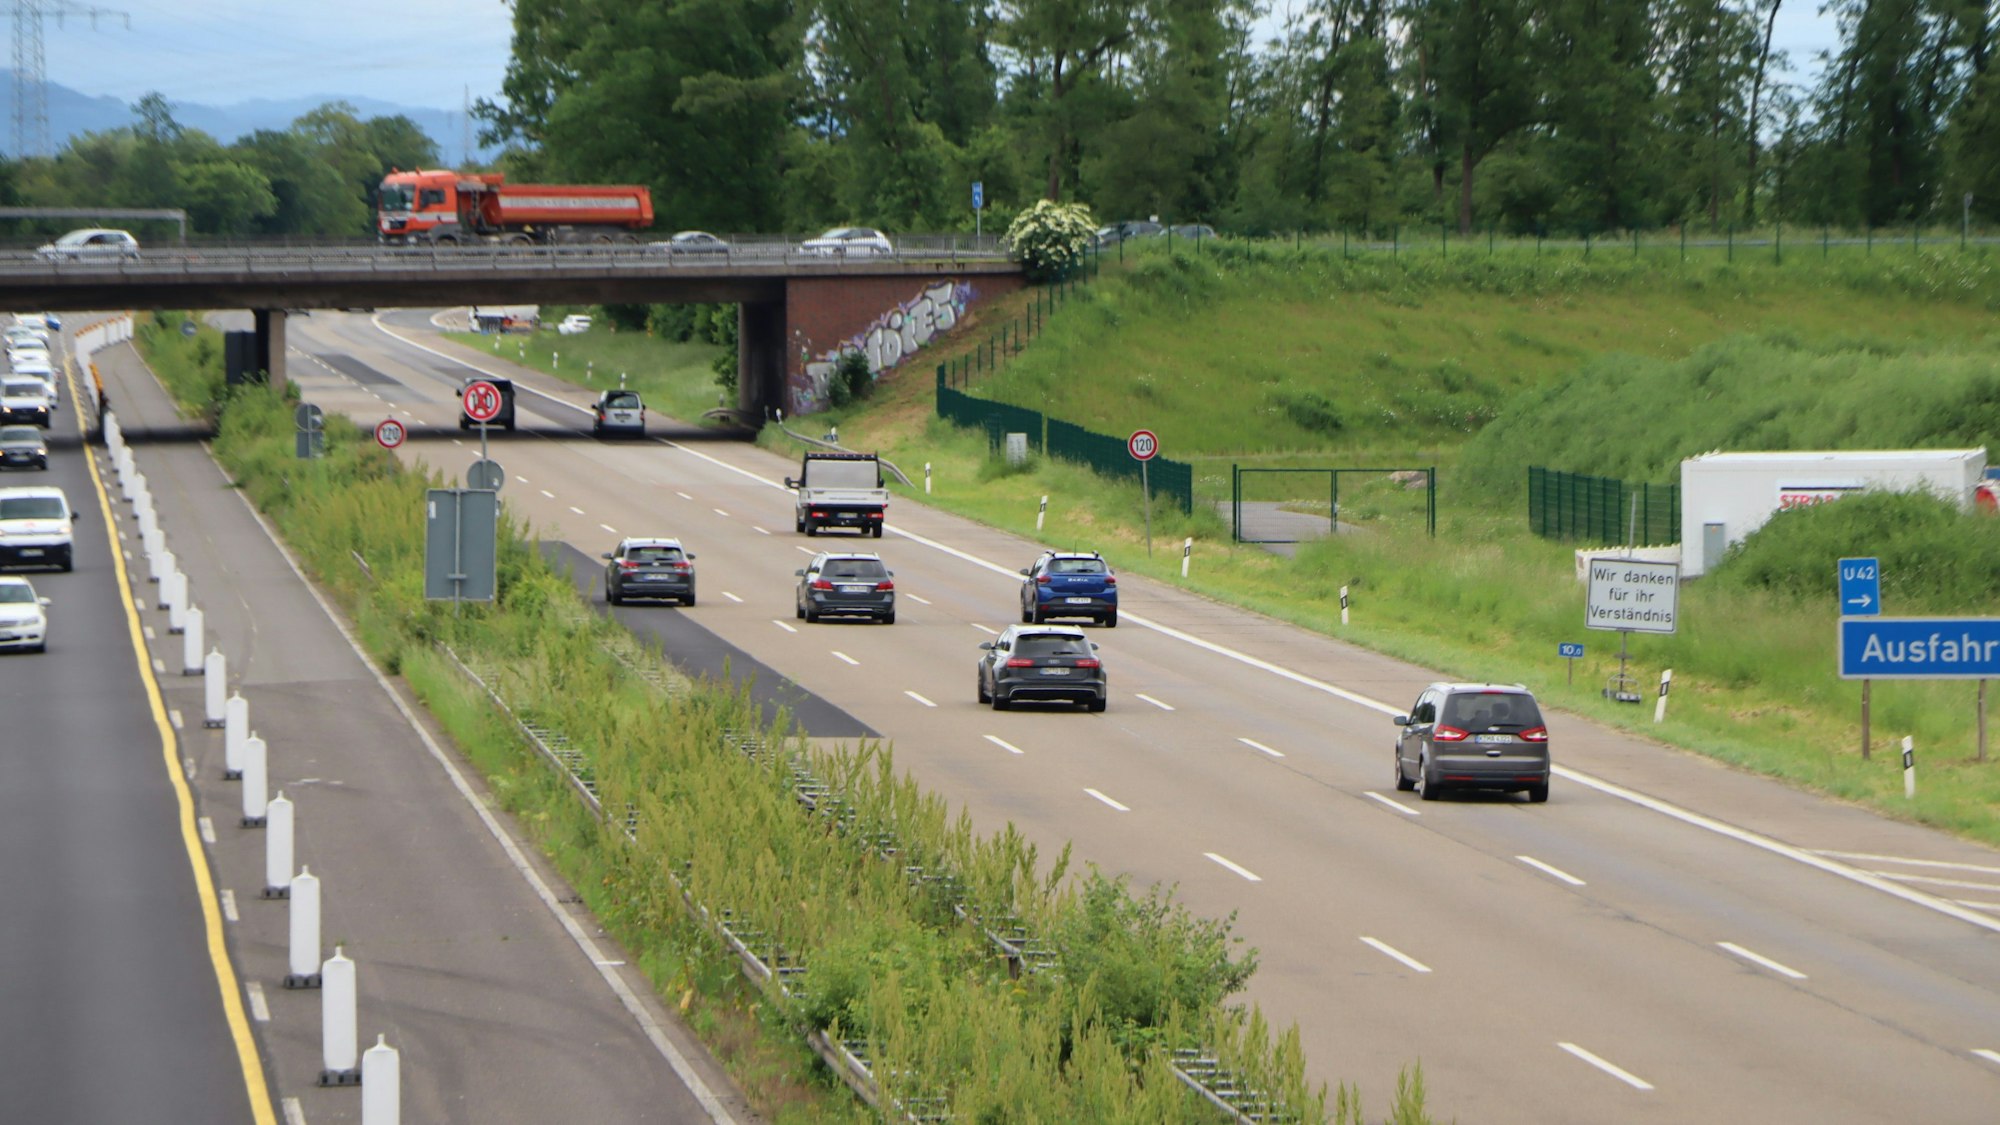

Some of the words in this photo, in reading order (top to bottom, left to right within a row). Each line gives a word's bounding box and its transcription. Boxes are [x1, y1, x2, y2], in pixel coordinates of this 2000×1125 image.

[382, 427, 399, 440] 120
[1135, 438, 1152, 451] 120
[1594, 567, 1617, 581] Wir
[1623, 570, 1674, 585] danken
[1609, 587, 1629, 601] für
[1635, 589, 1655, 603] ihr
[1590, 604, 1672, 623] Verständnis
